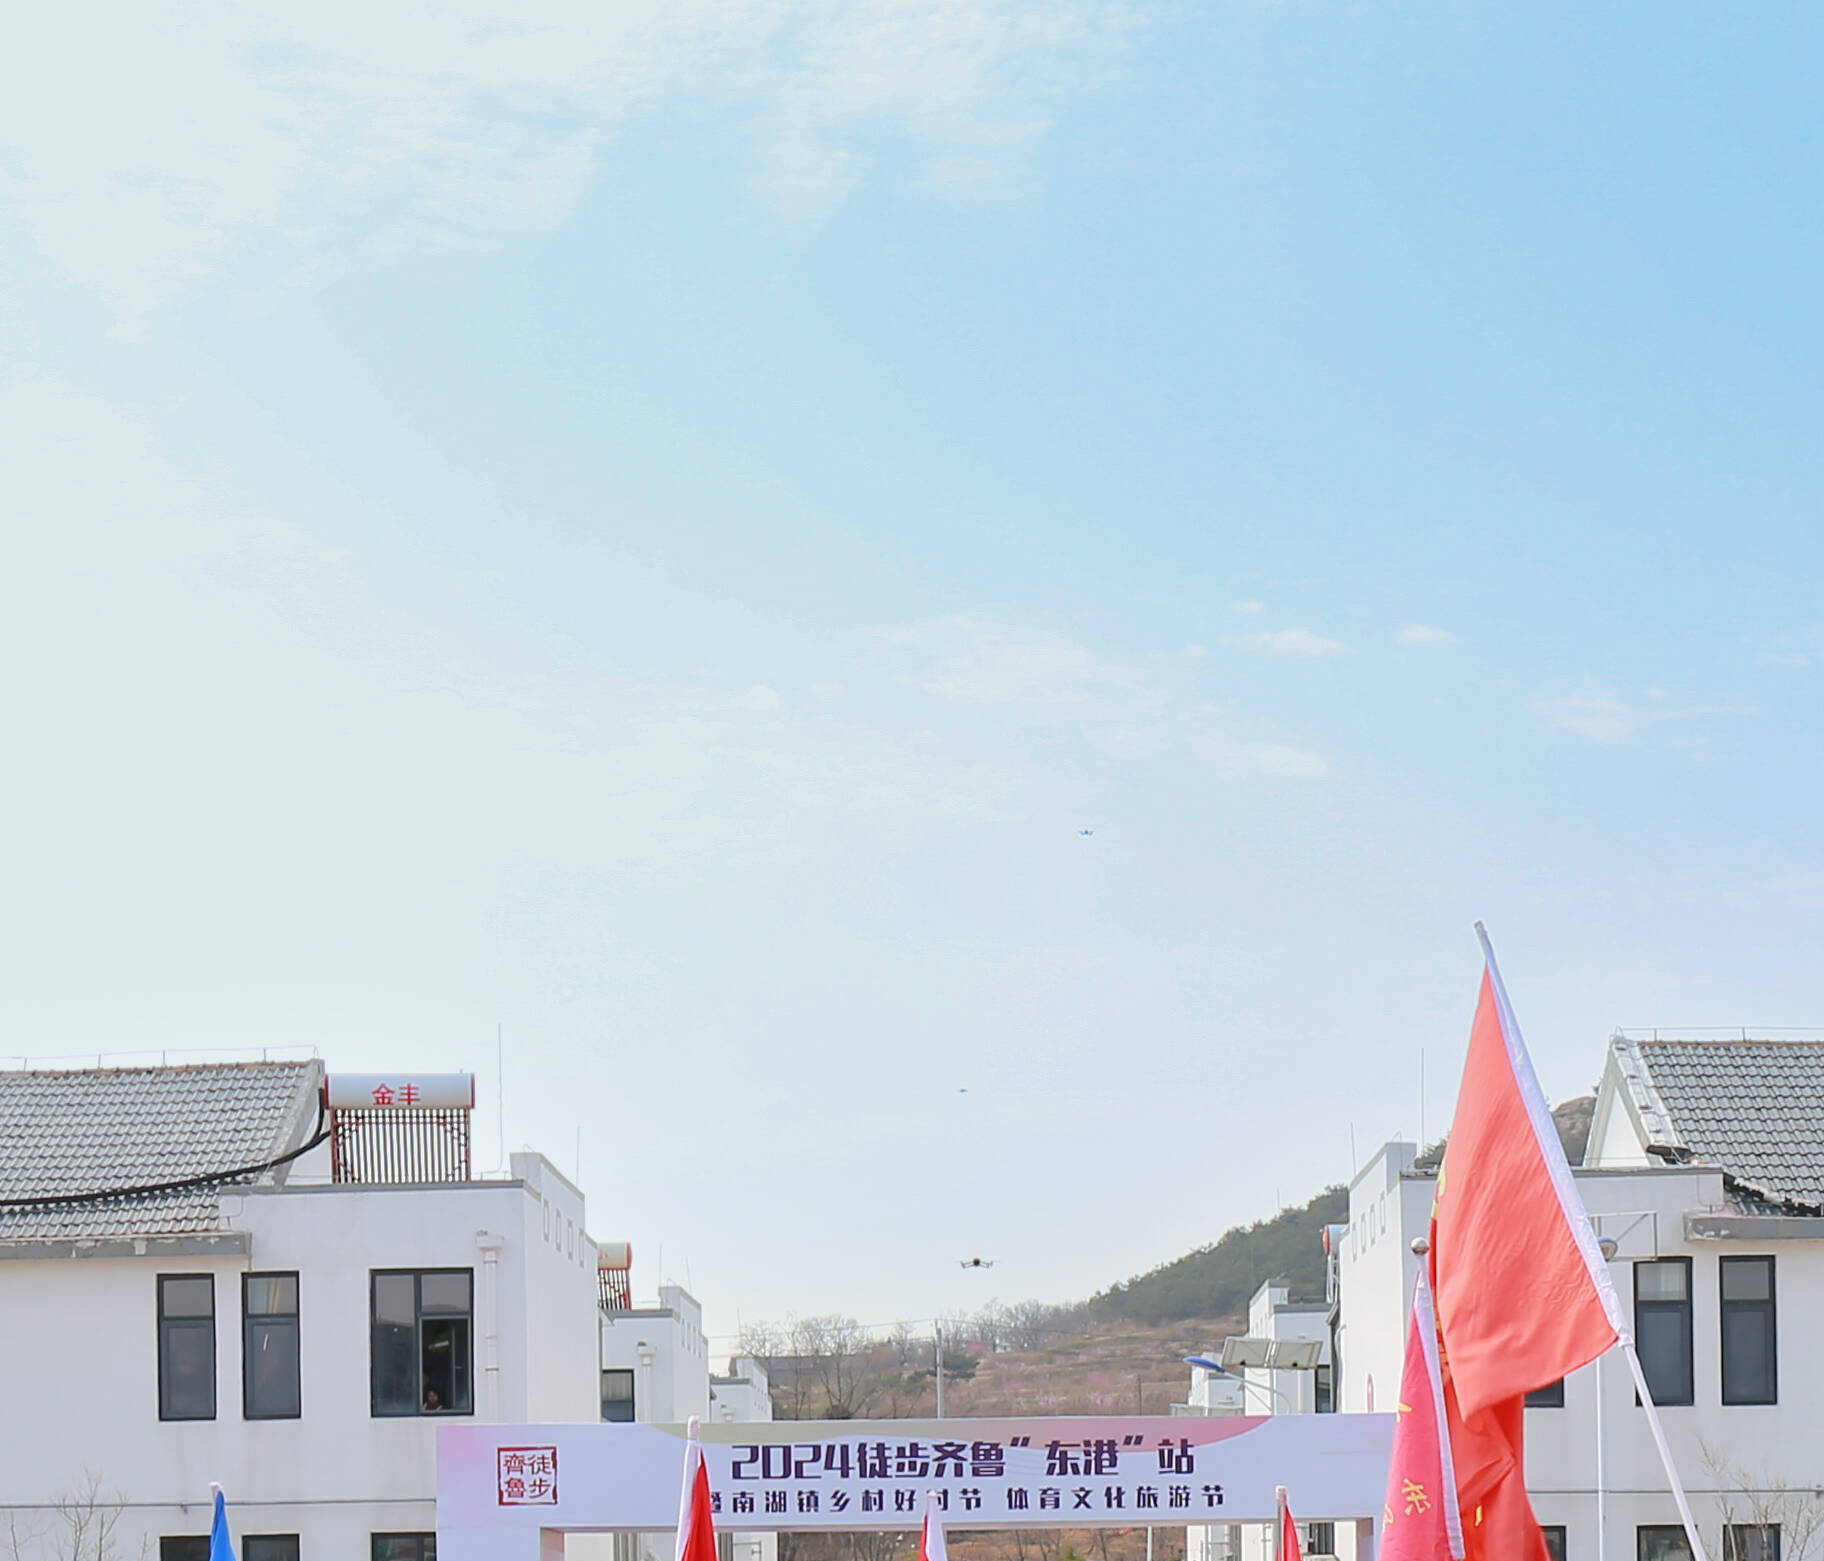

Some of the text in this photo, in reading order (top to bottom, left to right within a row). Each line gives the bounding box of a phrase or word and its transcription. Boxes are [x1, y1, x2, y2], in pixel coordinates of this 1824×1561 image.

[371, 1082, 422, 1106] 金丰
[731, 1434, 1195, 1481] 2024徒步齐鲁“东港”站
[1006, 1485, 1225, 1511] 体育文化旅游节
